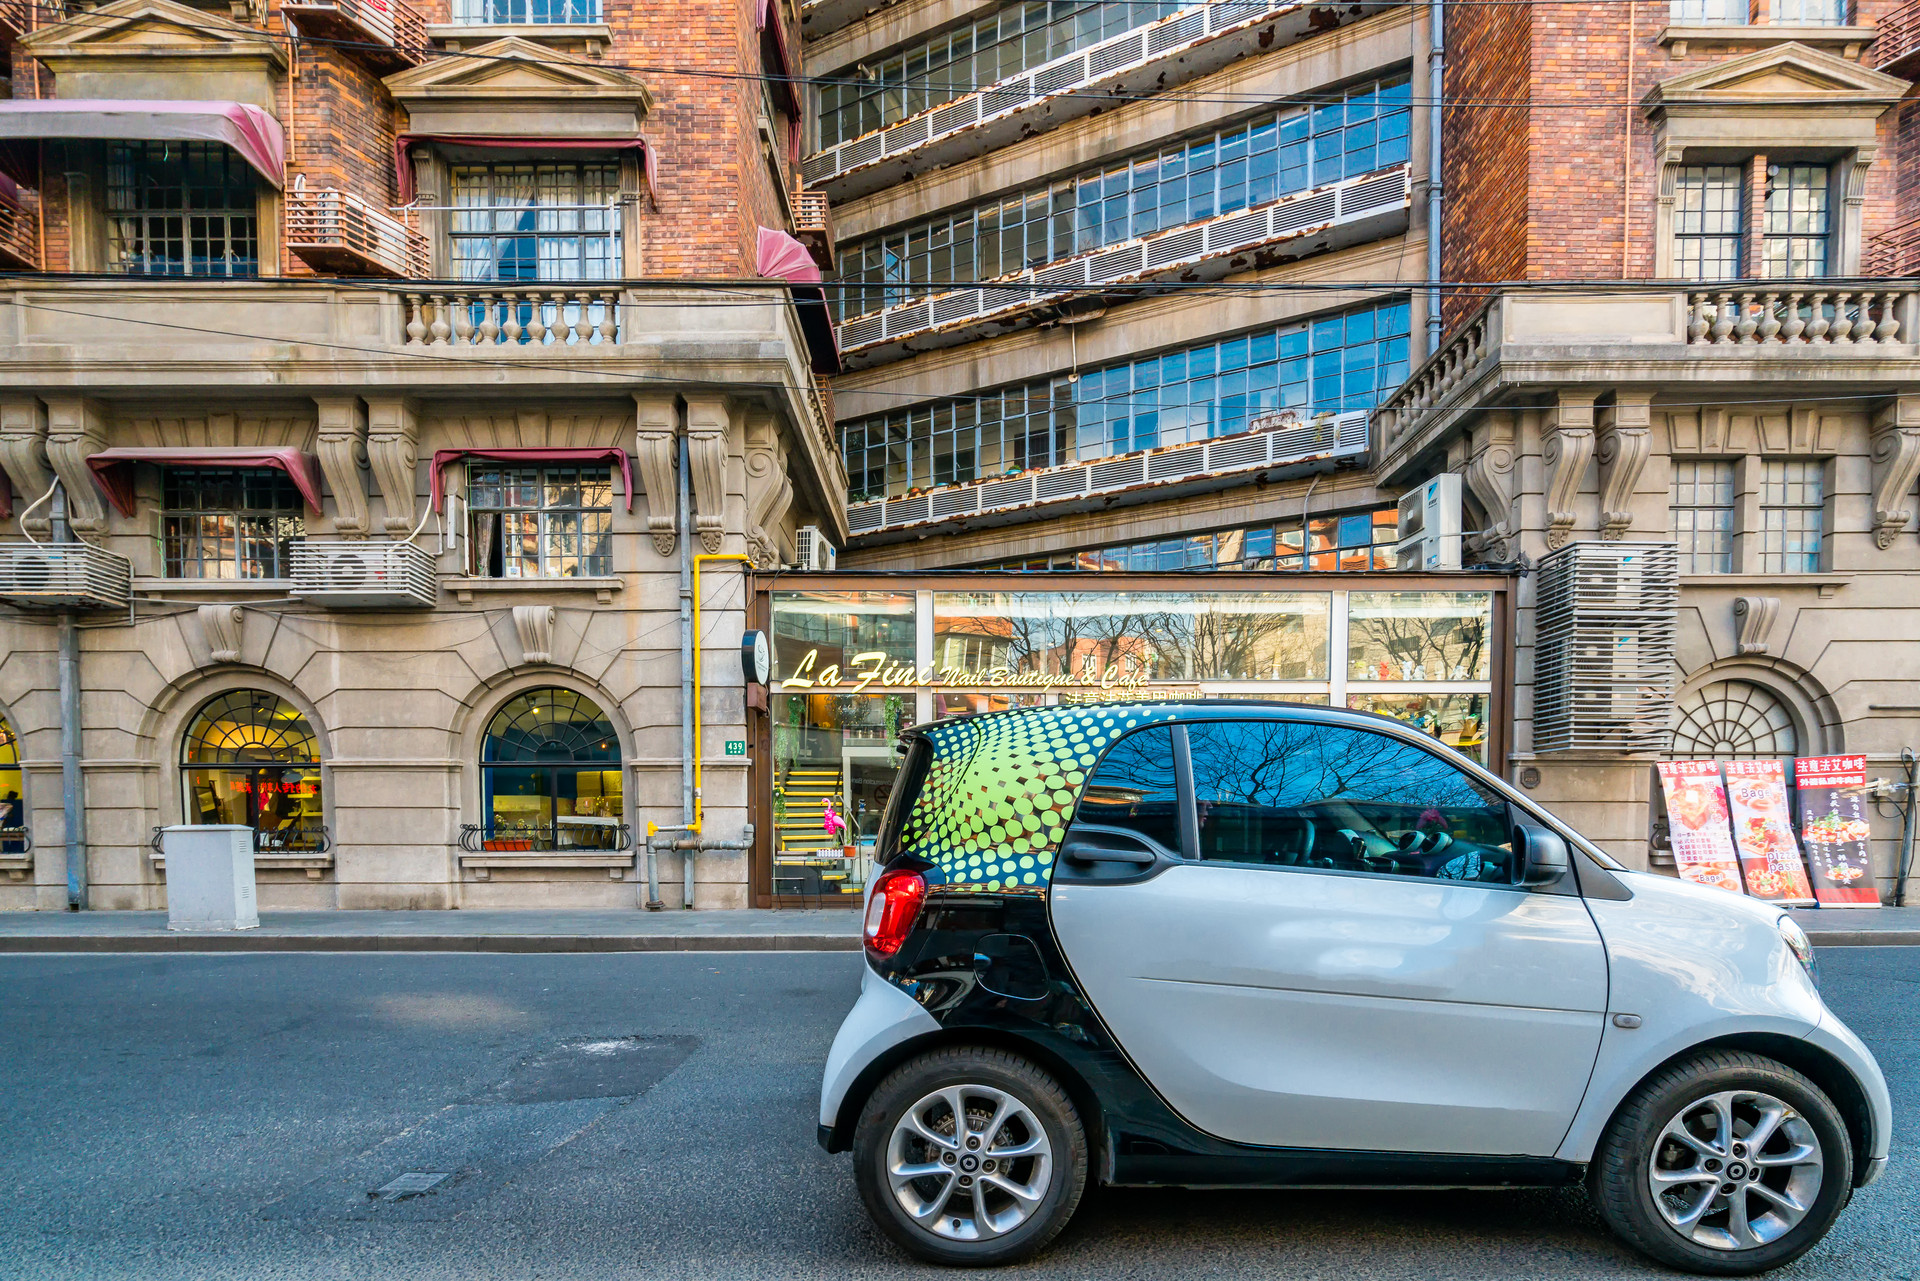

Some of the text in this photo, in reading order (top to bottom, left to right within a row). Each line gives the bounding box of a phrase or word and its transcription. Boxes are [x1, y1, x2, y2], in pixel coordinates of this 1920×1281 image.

[781, 649, 843, 689] La
[850, 651, 937, 694] Fini
[938, 665, 987, 688] Nail
[1080, 664, 1096, 687] &
[1101, 664, 1149, 692] Cafe
[728, 742, 743, 750] 439
[1797, 757, 1865, 773] 法意法艾咖啡
[1767, 851, 1799, 863] pizza
[1769, 862, 1801, 874] pasta
[1699, 873, 1723, 883] Bagel
